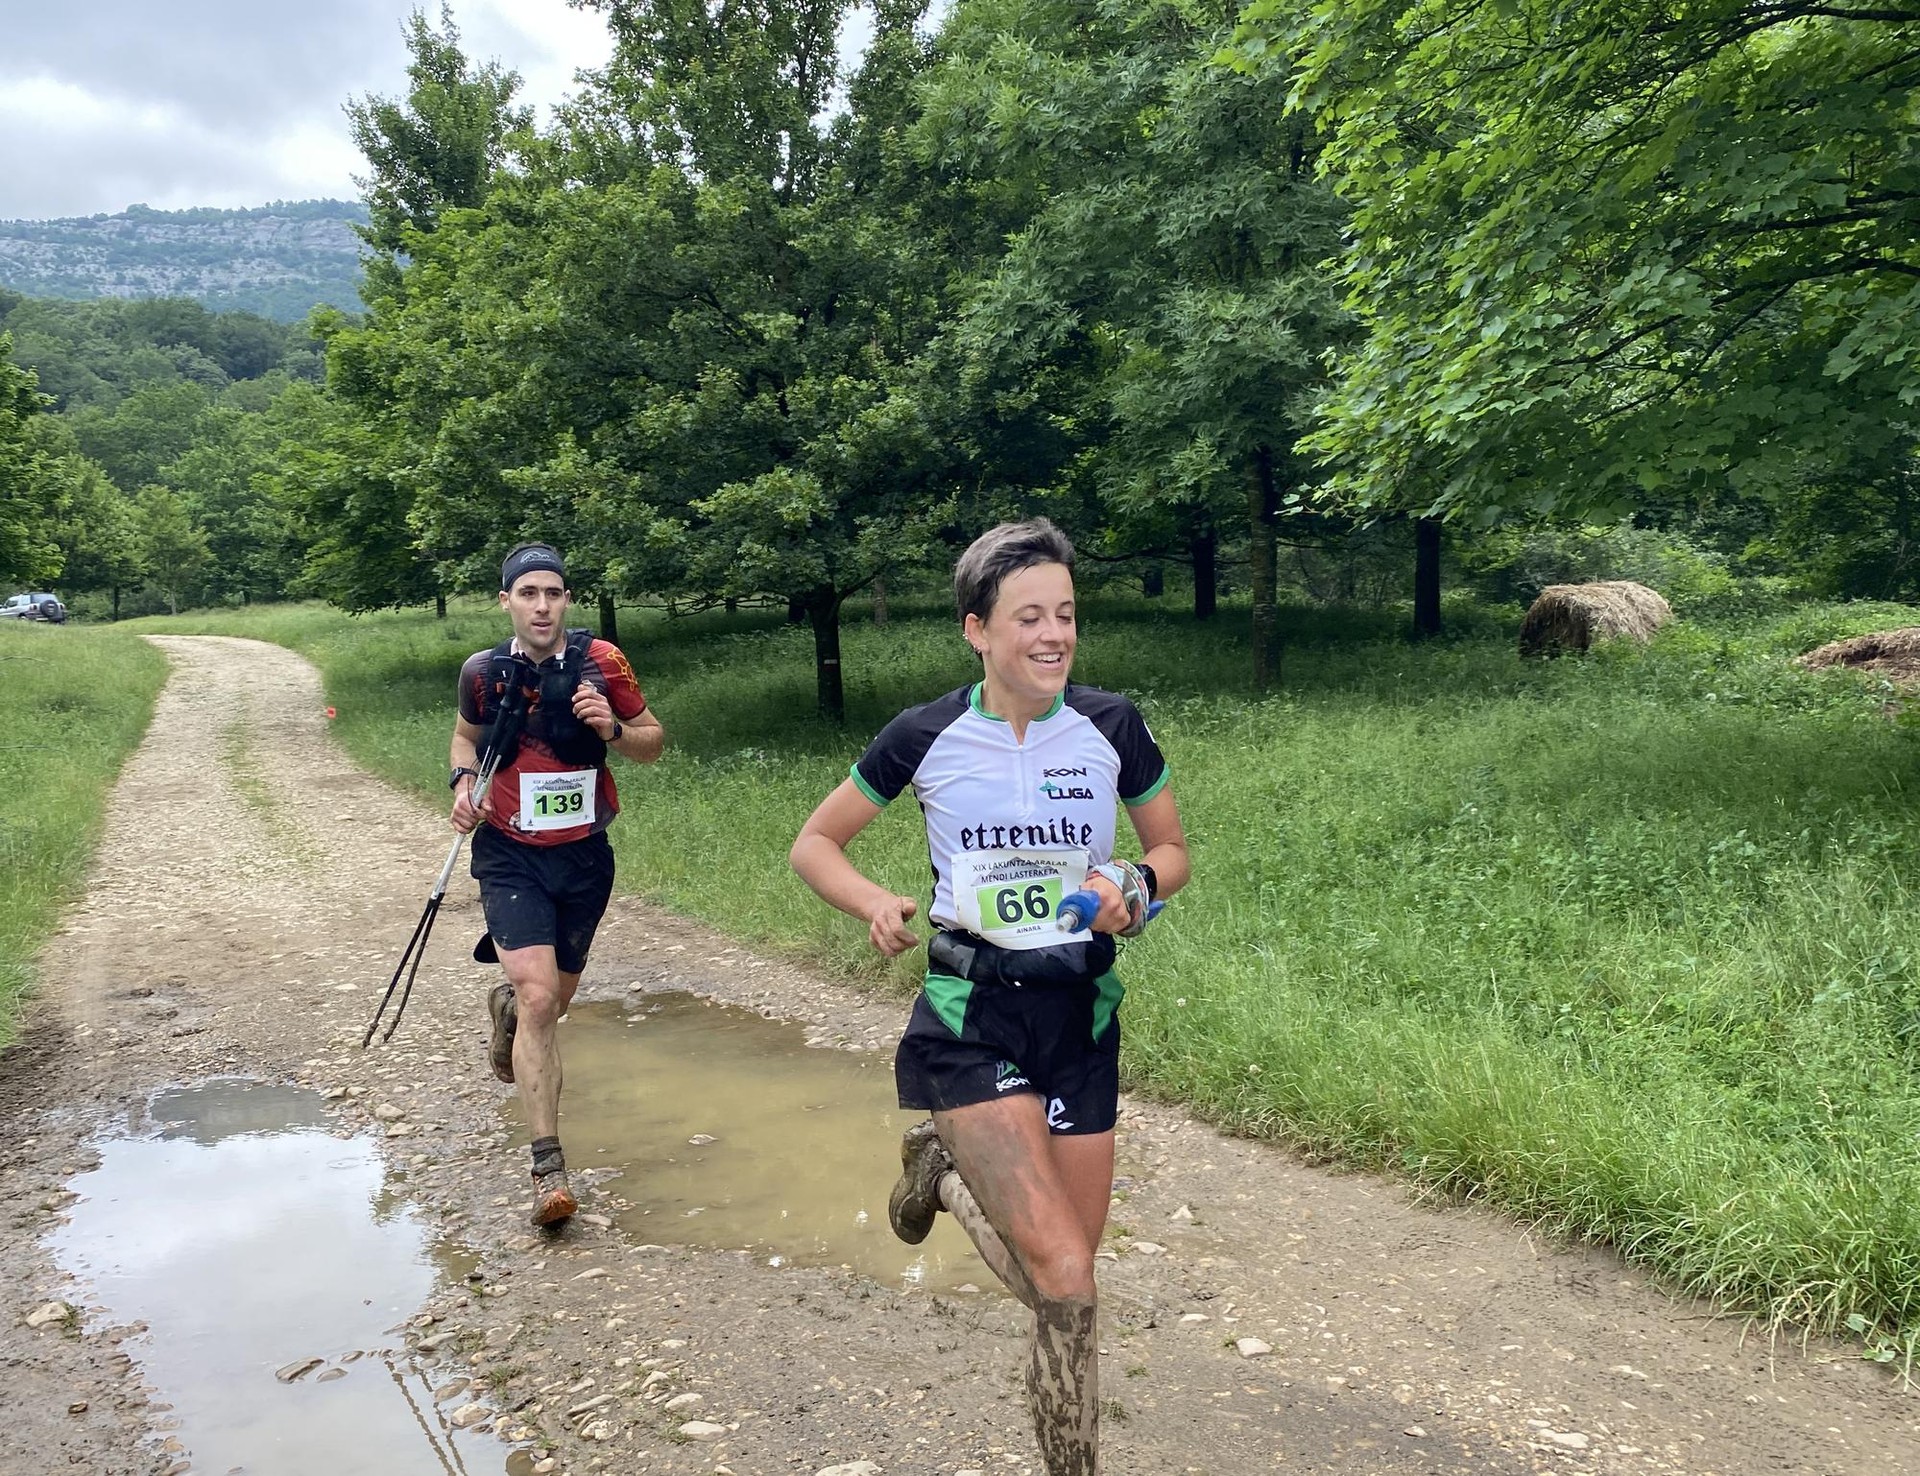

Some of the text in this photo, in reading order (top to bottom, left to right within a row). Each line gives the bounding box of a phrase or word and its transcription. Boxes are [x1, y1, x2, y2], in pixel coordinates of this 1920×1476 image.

[536, 792, 583, 814] 139
[972, 863, 987, 872] XIX
[981, 868, 1059, 883] MENDI LASTERKETA
[996, 884, 1050, 924] 66
[1016, 924, 1042, 934] AINARA
